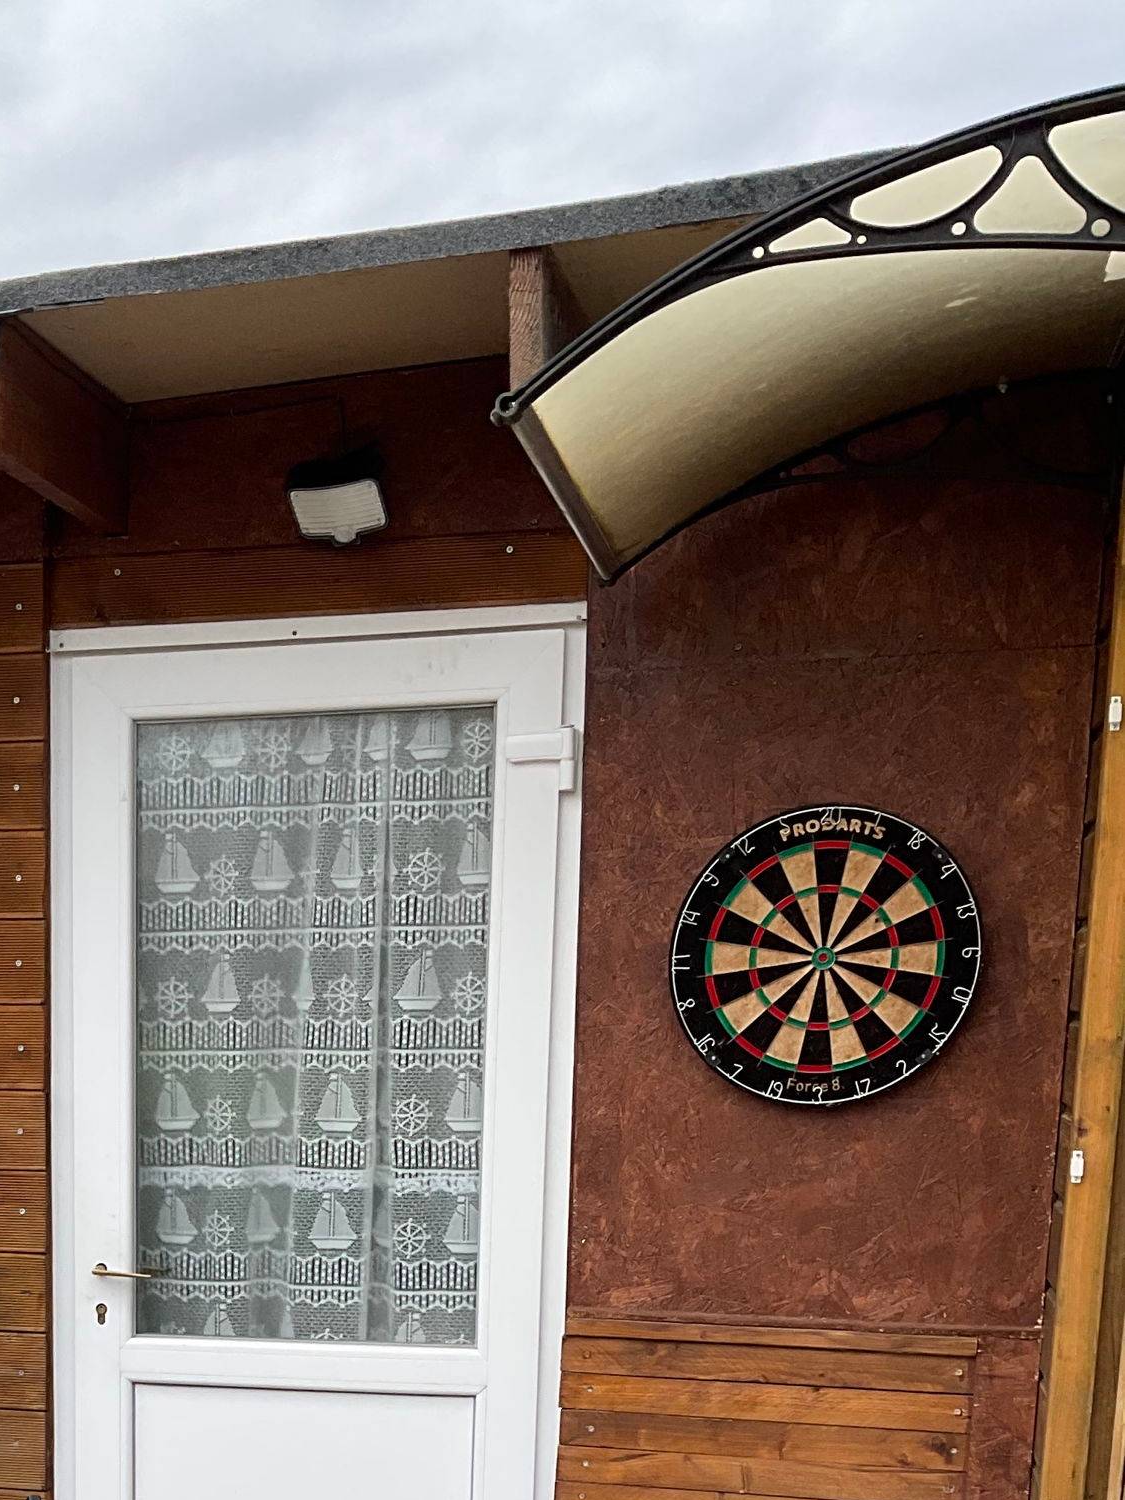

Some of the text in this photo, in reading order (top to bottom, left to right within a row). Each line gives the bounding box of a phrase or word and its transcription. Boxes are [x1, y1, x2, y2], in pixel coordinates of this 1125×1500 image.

[818, 807, 842, 825] 20
[779, 818, 887, 842] PRODARTS
[907, 828, 926, 850] 18
[733, 837, 756, 856] 12
